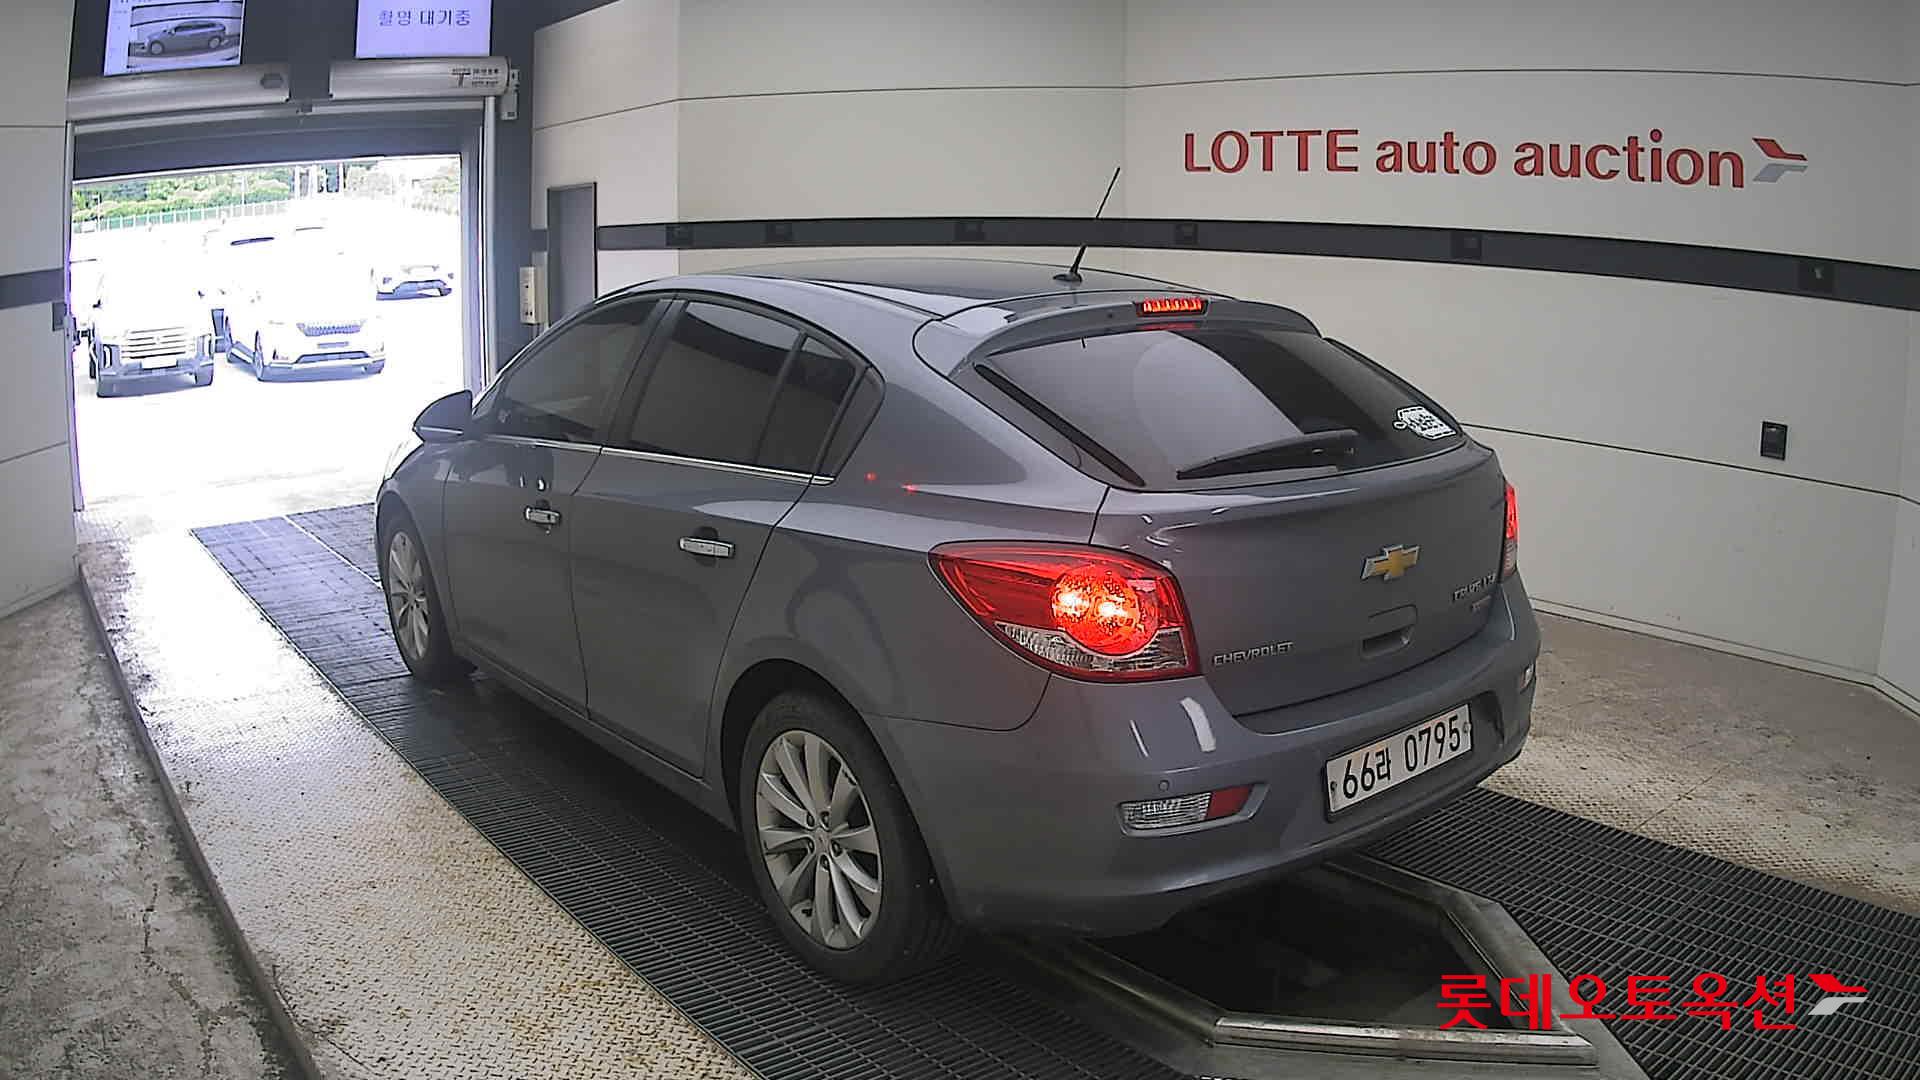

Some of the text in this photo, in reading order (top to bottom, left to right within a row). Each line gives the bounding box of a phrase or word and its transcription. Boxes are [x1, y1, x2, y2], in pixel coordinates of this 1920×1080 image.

[420, 10, 470, 26] 대기중
[1185, 129, 1744, 188] LOTTE auto auction
[1214, 642, 1294, 665] CHEVROLET
[1343, 715, 1460, 799] 66라 0795
